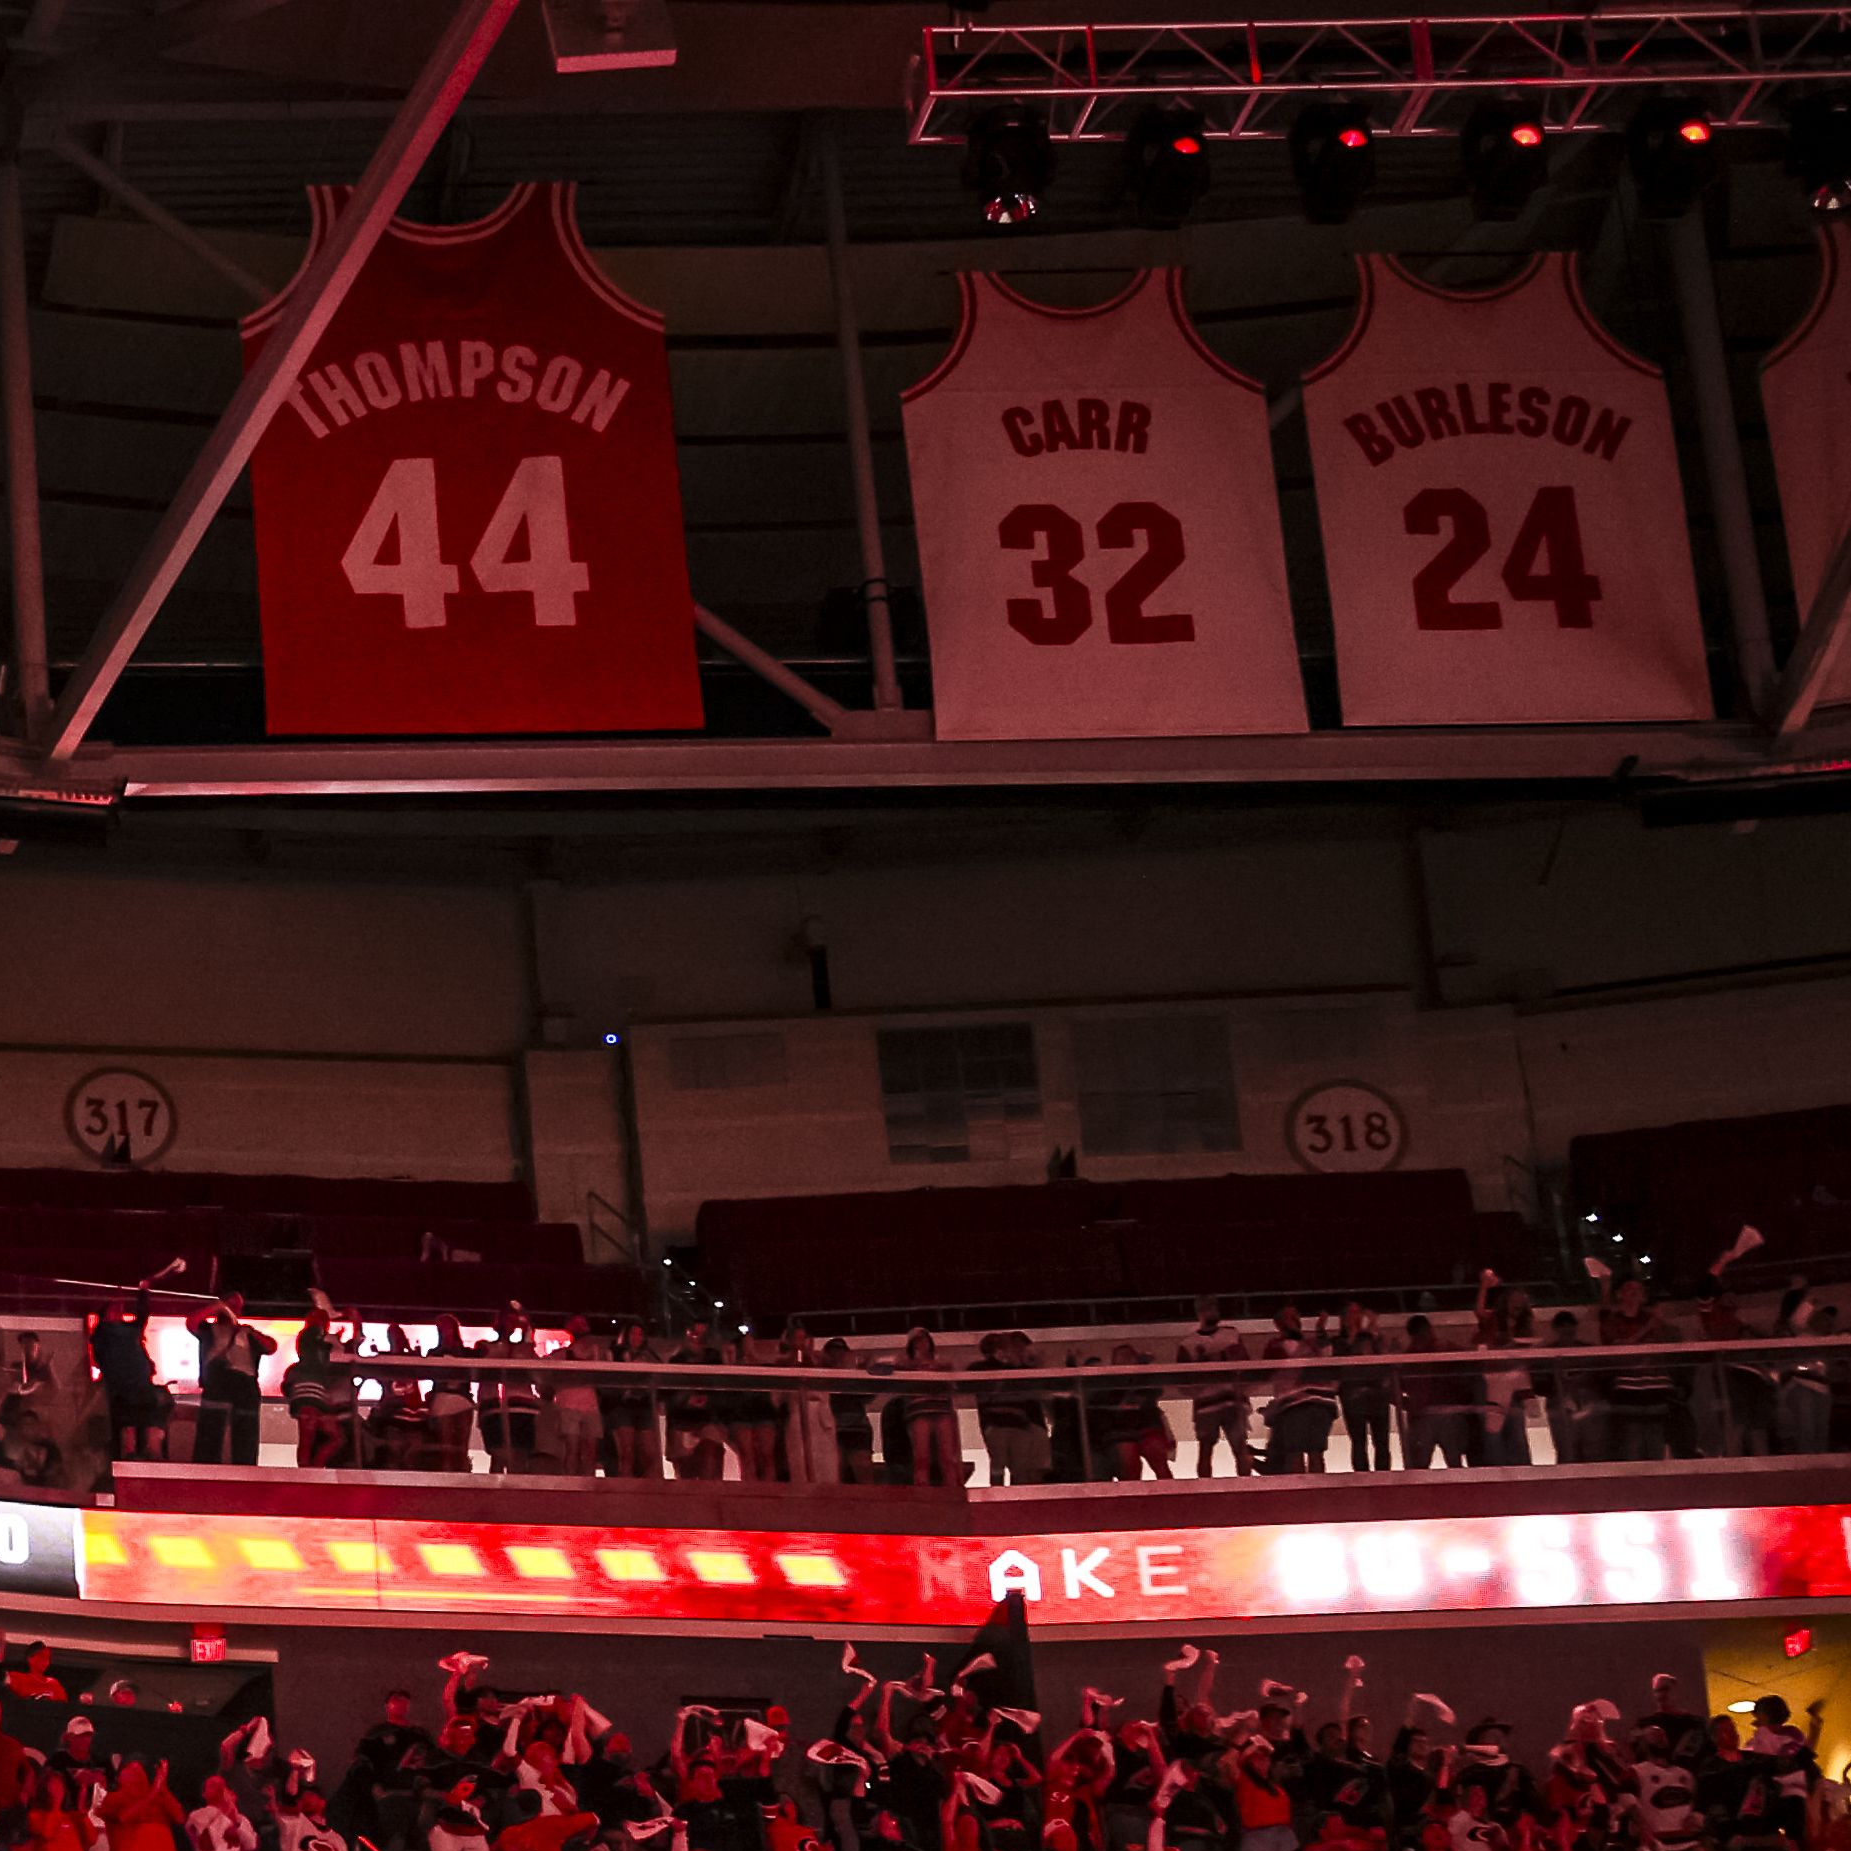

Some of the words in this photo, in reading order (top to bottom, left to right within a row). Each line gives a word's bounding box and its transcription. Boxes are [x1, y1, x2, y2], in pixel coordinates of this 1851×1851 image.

[286, 340, 631, 439] THOMPSON
[1001, 399, 1152, 457] CARR
[1343, 383, 1632, 467] BURLESON
[341, 455, 590, 629] 44
[998, 502, 1195, 647] 32
[1403, 485, 1602, 631] 24
[87, 1099, 161, 1138] 317
[1306, 1113, 1392, 1154] 318
